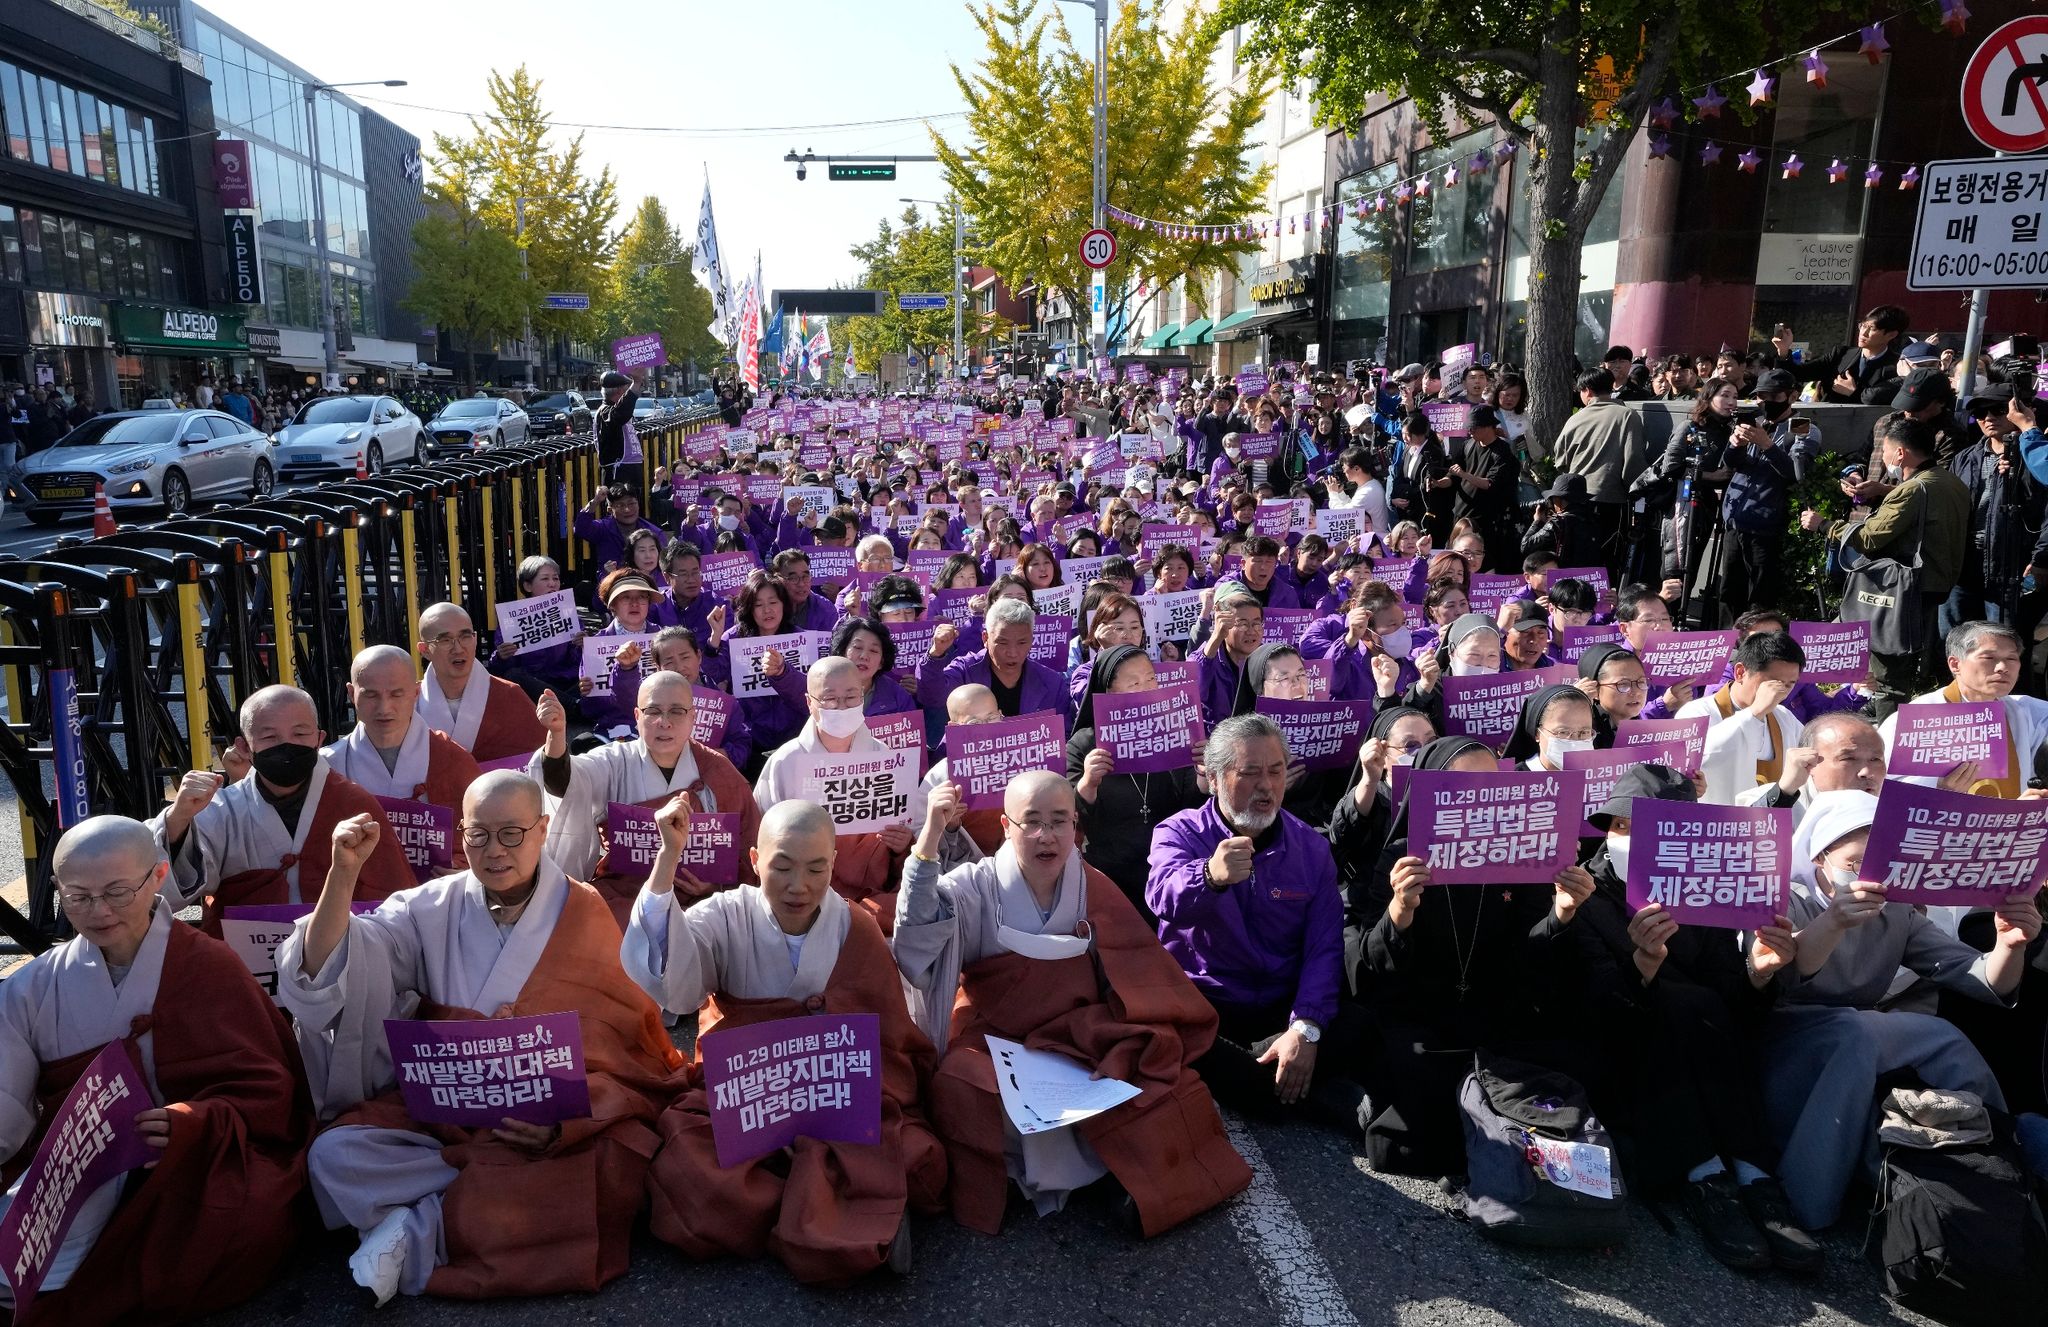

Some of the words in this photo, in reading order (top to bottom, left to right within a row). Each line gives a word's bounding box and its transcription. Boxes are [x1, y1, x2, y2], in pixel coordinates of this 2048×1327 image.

[1946, 215, 1978, 244] 매
[2011, 213, 2041, 243] 일
[233, 219, 252, 300] ALPEDO
[1088, 239, 1107, 259] 50
[1919, 251, 2048, 278] (16:00~05:00
[164, 311, 218, 333] ALPEDO
[249, 333, 281, 346] HOUSTON
[616, 342, 660, 361] 재발방지대책
[1429, 413, 1463, 422] 특별법을
[1242, 440, 1278, 449] 재발방지대책
[1247, 447, 1272, 455] 마련하라!
[1329, 520, 1356, 533] 진상을
[702, 563, 754, 581] 재발방지대책
[706, 562, 723, 570] 10.29
[725, 559, 740, 567] 이태원
[509, 606, 528, 618] 10.29
[529, 600, 550, 614] 이태원
[551, 593, 564, 608] 참사
[1046, 589, 1063, 600] 이태원
[1164, 599, 1180, 608] 10.29
[1181, 596, 1199, 604] 이태원
[517, 604, 561, 632] 진상을
[1048, 620, 1061, 631] 참사
[1283, 615, 1301, 623] 이태원
[513, 617, 574, 649] 규명하라!
[742, 645, 765, 656] 10.29
[791, 635, 807, 647] 참사
[902, 630, 924, 640] 이태원
[1574, 636, 1594, 645] 10.29
[1657, 642, 1679, 650] 10.29
[1682, 639, 1707, 648] 이태원
[1802, 634, 1825, 644] 10.29
[1827, 632, 1850, 642] 이태원
[1643, 646, 1729, 665] 재발방지대책
[1651, 660, 1712, 677] 마련하라!
[1459, 689, 1487, 700] 10.29
[1490, 683, 1521, 697] 이태원
[1524, 675, 1544, 690] 참사
[1109, 708, 1138, 722] 10.29
[1141, 700, 1170, 716] 이태원
[1172, 690, 1188, 708] 참사
[1301, 712, 1331, 724] 이태원
[1334, 706, 1353, 721] 참사
[1449, 693, 1532, 719] 재발방지
[1912, 718, 1941, 729] 10.29
[1943, 713, 1973, 727] 이태원
[1976, 708, 1994, 722] 참사
[894, 717, 912, 731] 참사
[1100, 704, 1199, 744] 재발방지대책
[1898, 723, 2003, 748] 재발방지대책
[962, 740, 993, 754] 10.29
[996, 732, 1028, 749] 이태원
[1030, 724, 1050, 744] 참사
[1117, 729, 1191, 760] 마련하라!
[1628, 733, 1654, 745] 10.29
[1655, 730, 1681, 742] 이태원
[814, 766, 845, 778] 10.29
[848, 761, 881, 775] 이태원
[884, 753, 905, 770] 참사
[952, 740, 1060, 778] 재발방지대책
[1911, 743, 1990, 764] 마련하라!
[824, 773, 895, 801] 진상을
[1434, 790, 1475, 806] 10.29
[1480, 785, 1525, 802] 이태원
[1529, 777, 1560, 799] 참사
[412, 811, 435, 827] 참사
[625, 820, 656, 831] 10.29
[697, 818, 721, 831] 참사
[1433, 801, 1557, 839] 특별법을
[1657, 821, 1703, 837] 10.29
[1707, 821, 1751, 837] 이태원
[1755, 813, 1777, 835] 참사
[1907, 807, 1961, 827] 10.29
[1965, 813, 2022, 828] 이태원
[1426, 833, 1559, 870] 제정하라!
[1655, 840, 1777, 873] 특별법을
[1899, 827, 2048, 861] 특별법을
[1883, 857, 2040, 891] 제정하라!
[1647, 875, 1781, 907] 제정하라!
[412, 1042, 457, 1057] 10.29
[462, 1036, 513, 1056] 이태원
[517, 1024, 552, 1049] 참사
[726, 1046, 769, 1074] 10.29
[773, 1034, 819, 1058] 이태원
[824, 1024, 855, 1048] 참사
[401, 1045, 573, 1086] 재발방지대책
[714, 1049, 871, 1111] 재발방지대책
[431, 1078, 553, 1110] 마련하라!
[740, 1082, 852, 1133] 마련하라!
[14, 1073, 130, 1287] 재발방지대책
[17, 1179, 44, 1241] 10.29
[44, 1114, 74, 1180] 이태원
[34, 1120, 116, 1274] 마련하라!
